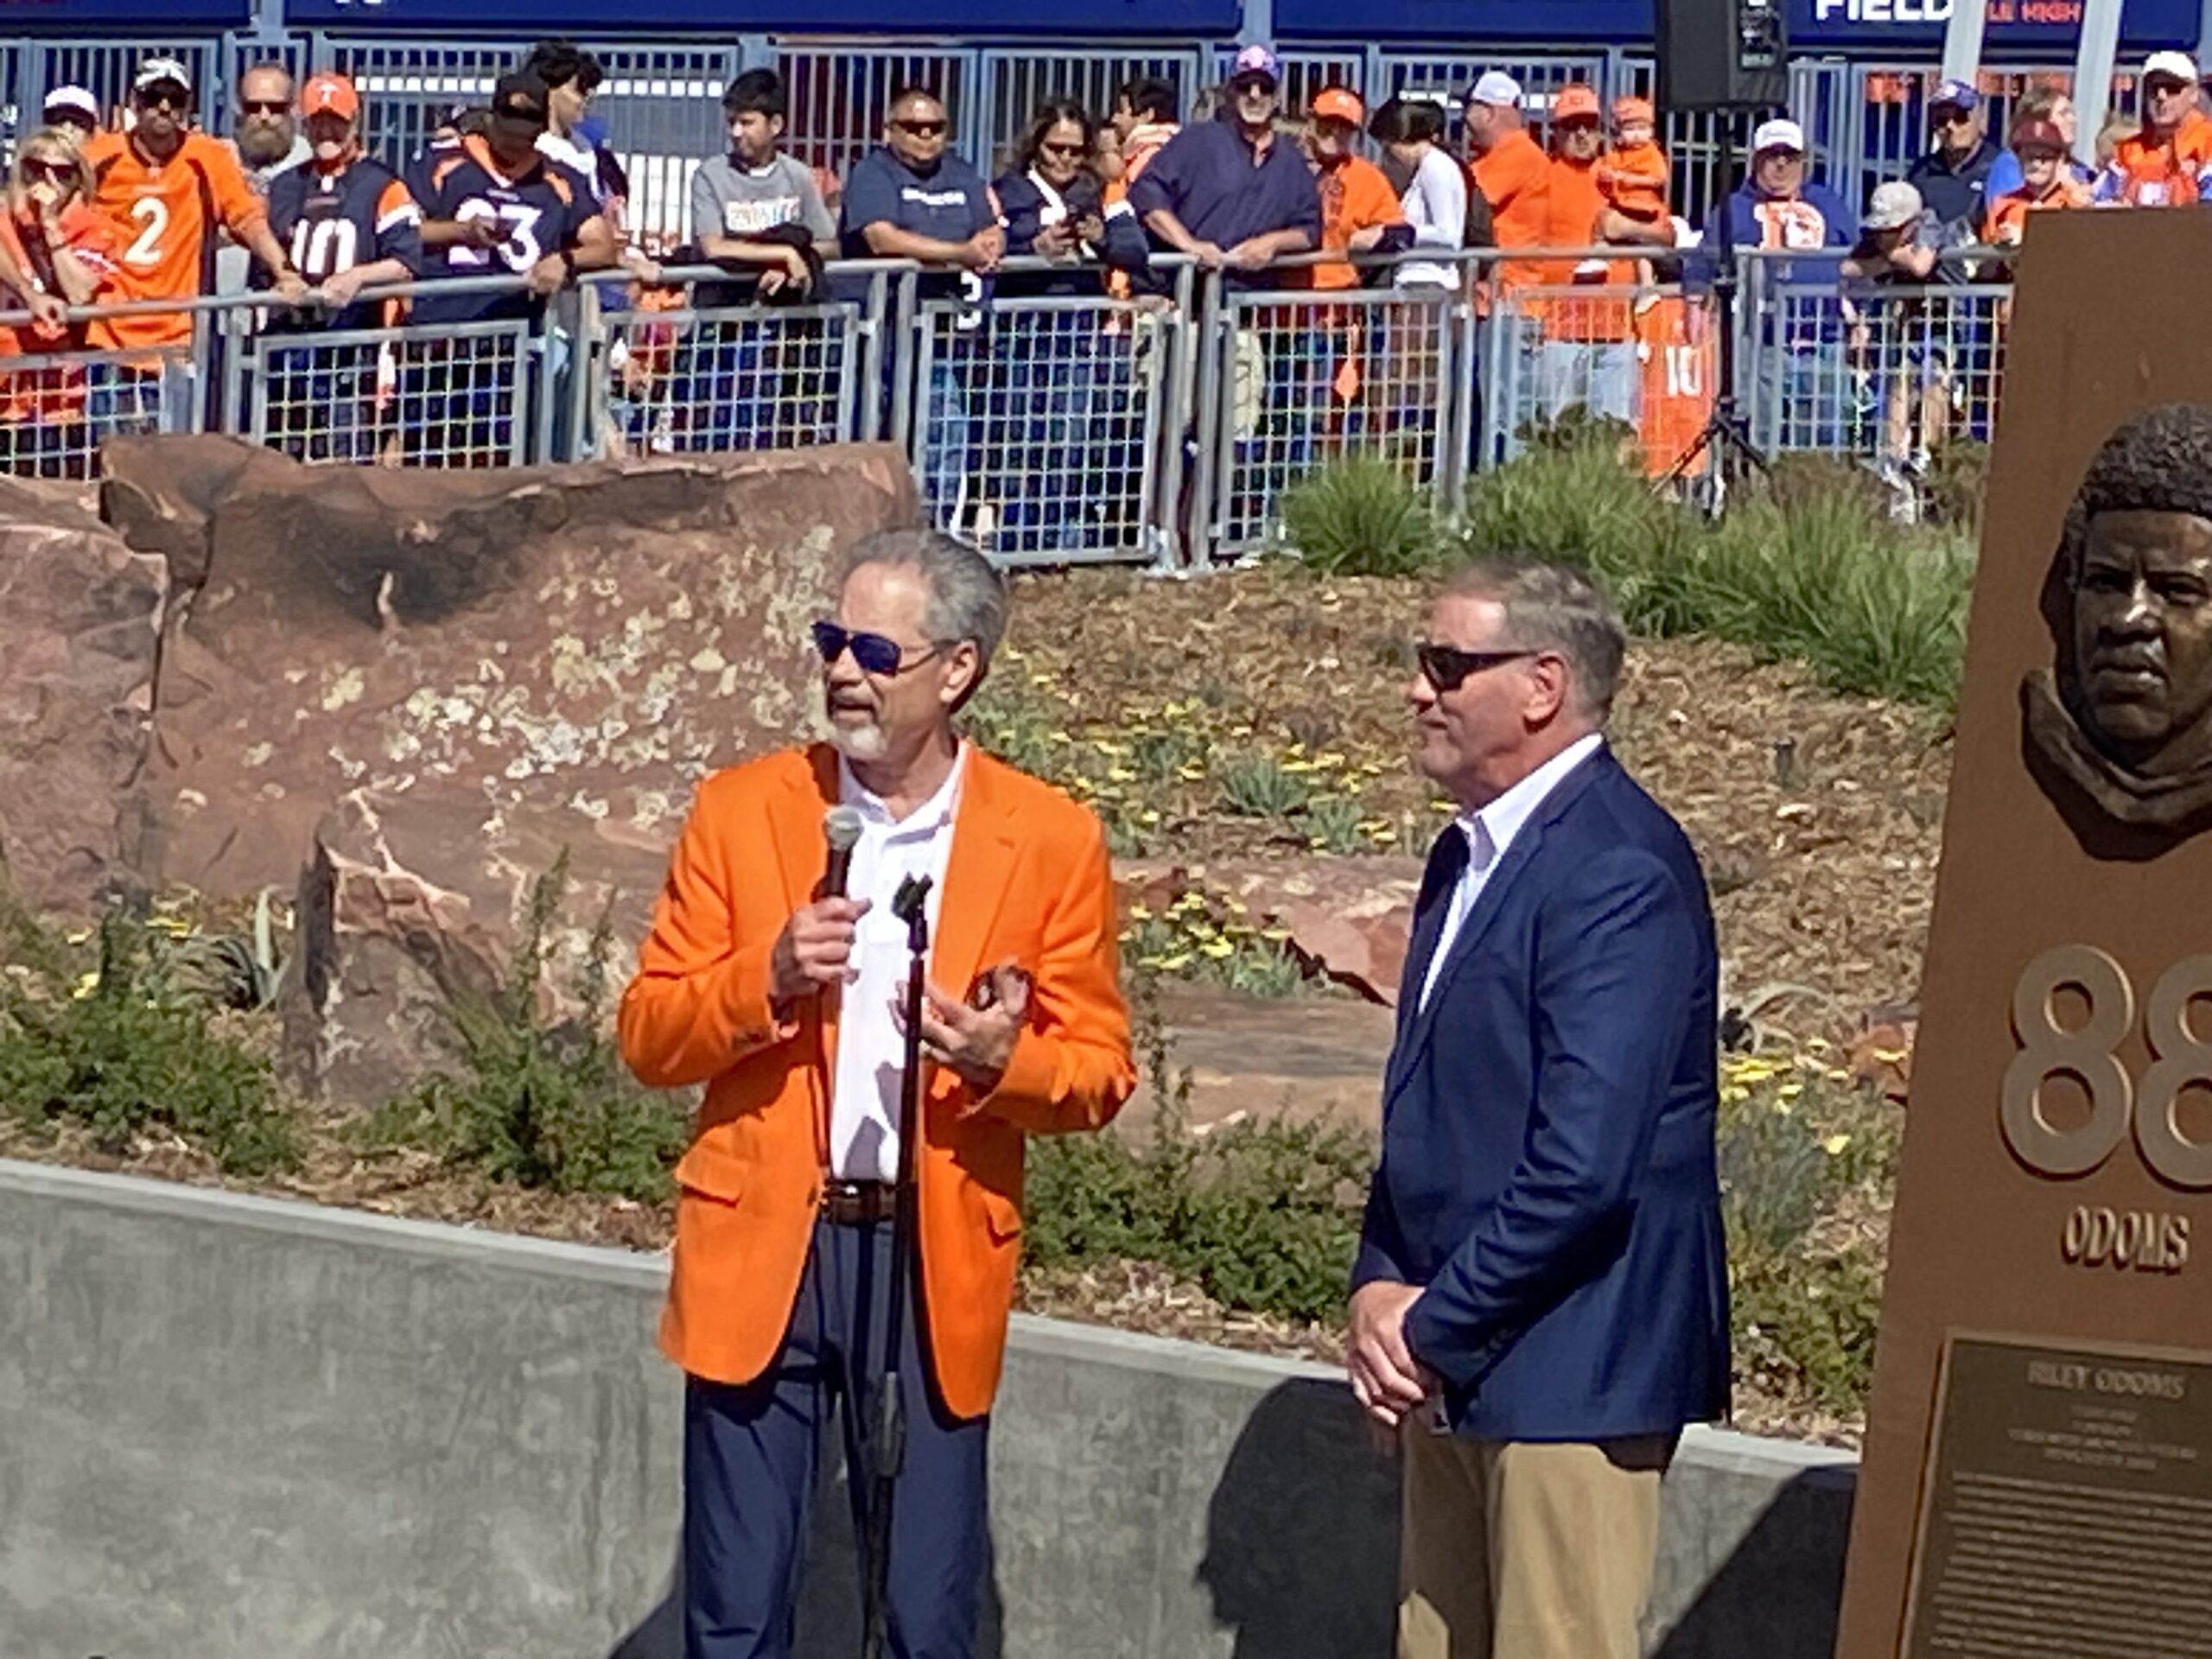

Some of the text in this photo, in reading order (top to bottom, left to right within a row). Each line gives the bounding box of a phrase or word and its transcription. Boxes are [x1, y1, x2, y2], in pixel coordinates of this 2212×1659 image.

[1815, 0, 1954, 21] FIELD
[2021, 2, 2081, 23] HIGH
[124, 196, 169, 265] 2
[291, 218, 357, 276] 10
[1665, 345, 1702, 397] 10
[2063, 1205, 2190, 1273] ODOMS
[2027, 1360, 2186, 1401] RILEY ODOMS
